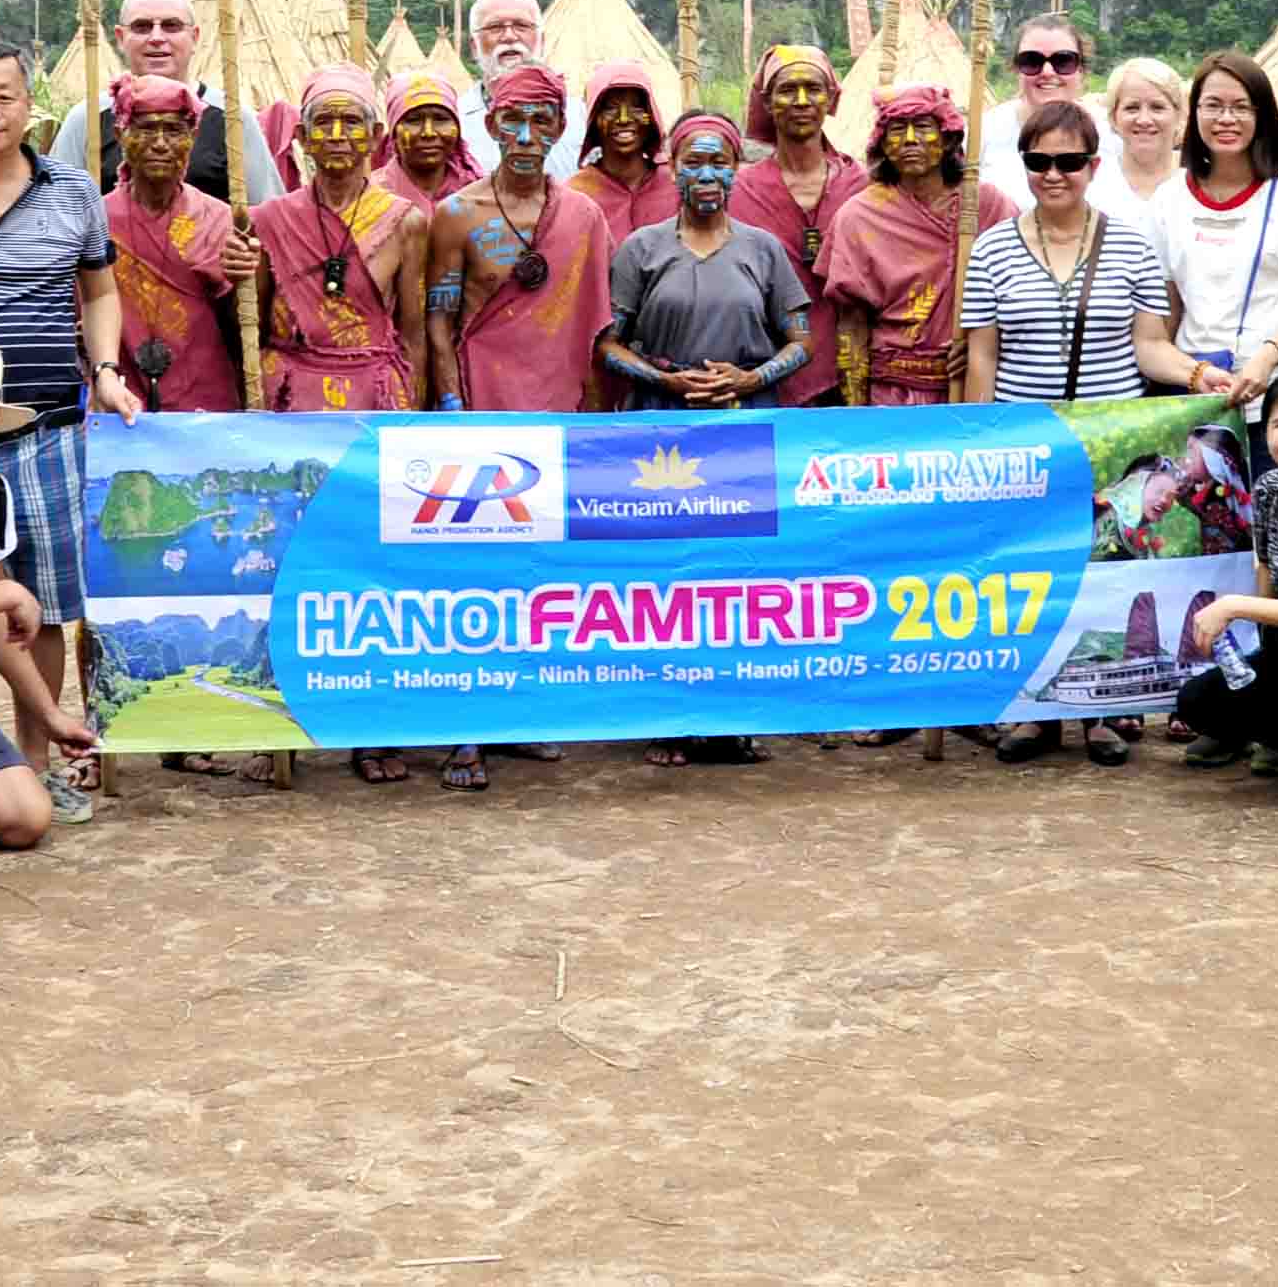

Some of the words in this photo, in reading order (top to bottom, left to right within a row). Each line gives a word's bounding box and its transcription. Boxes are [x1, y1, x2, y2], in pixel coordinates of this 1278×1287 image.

[798, 454, 897, 492] APT
[906, 447, 1049, 490] TRAVEL
[576, 498, 673, 517] Vietnam
[676, 495, 751, 515] Airline
[887, 572, 1053, 642] 2017
[307, 669, 372, 690] Hanoi
[394, 668, 471, 691] Halong
[478, 665, 518, 689] bay
[539, 665, 590, 684] Ninh
[662, 664, 714, 684] Sapa
[736, 659, 799, 680] Hanoi
[805, 654, 868, 679] (20/5
[888, 648, 1020, 674] 26/5/2017)
